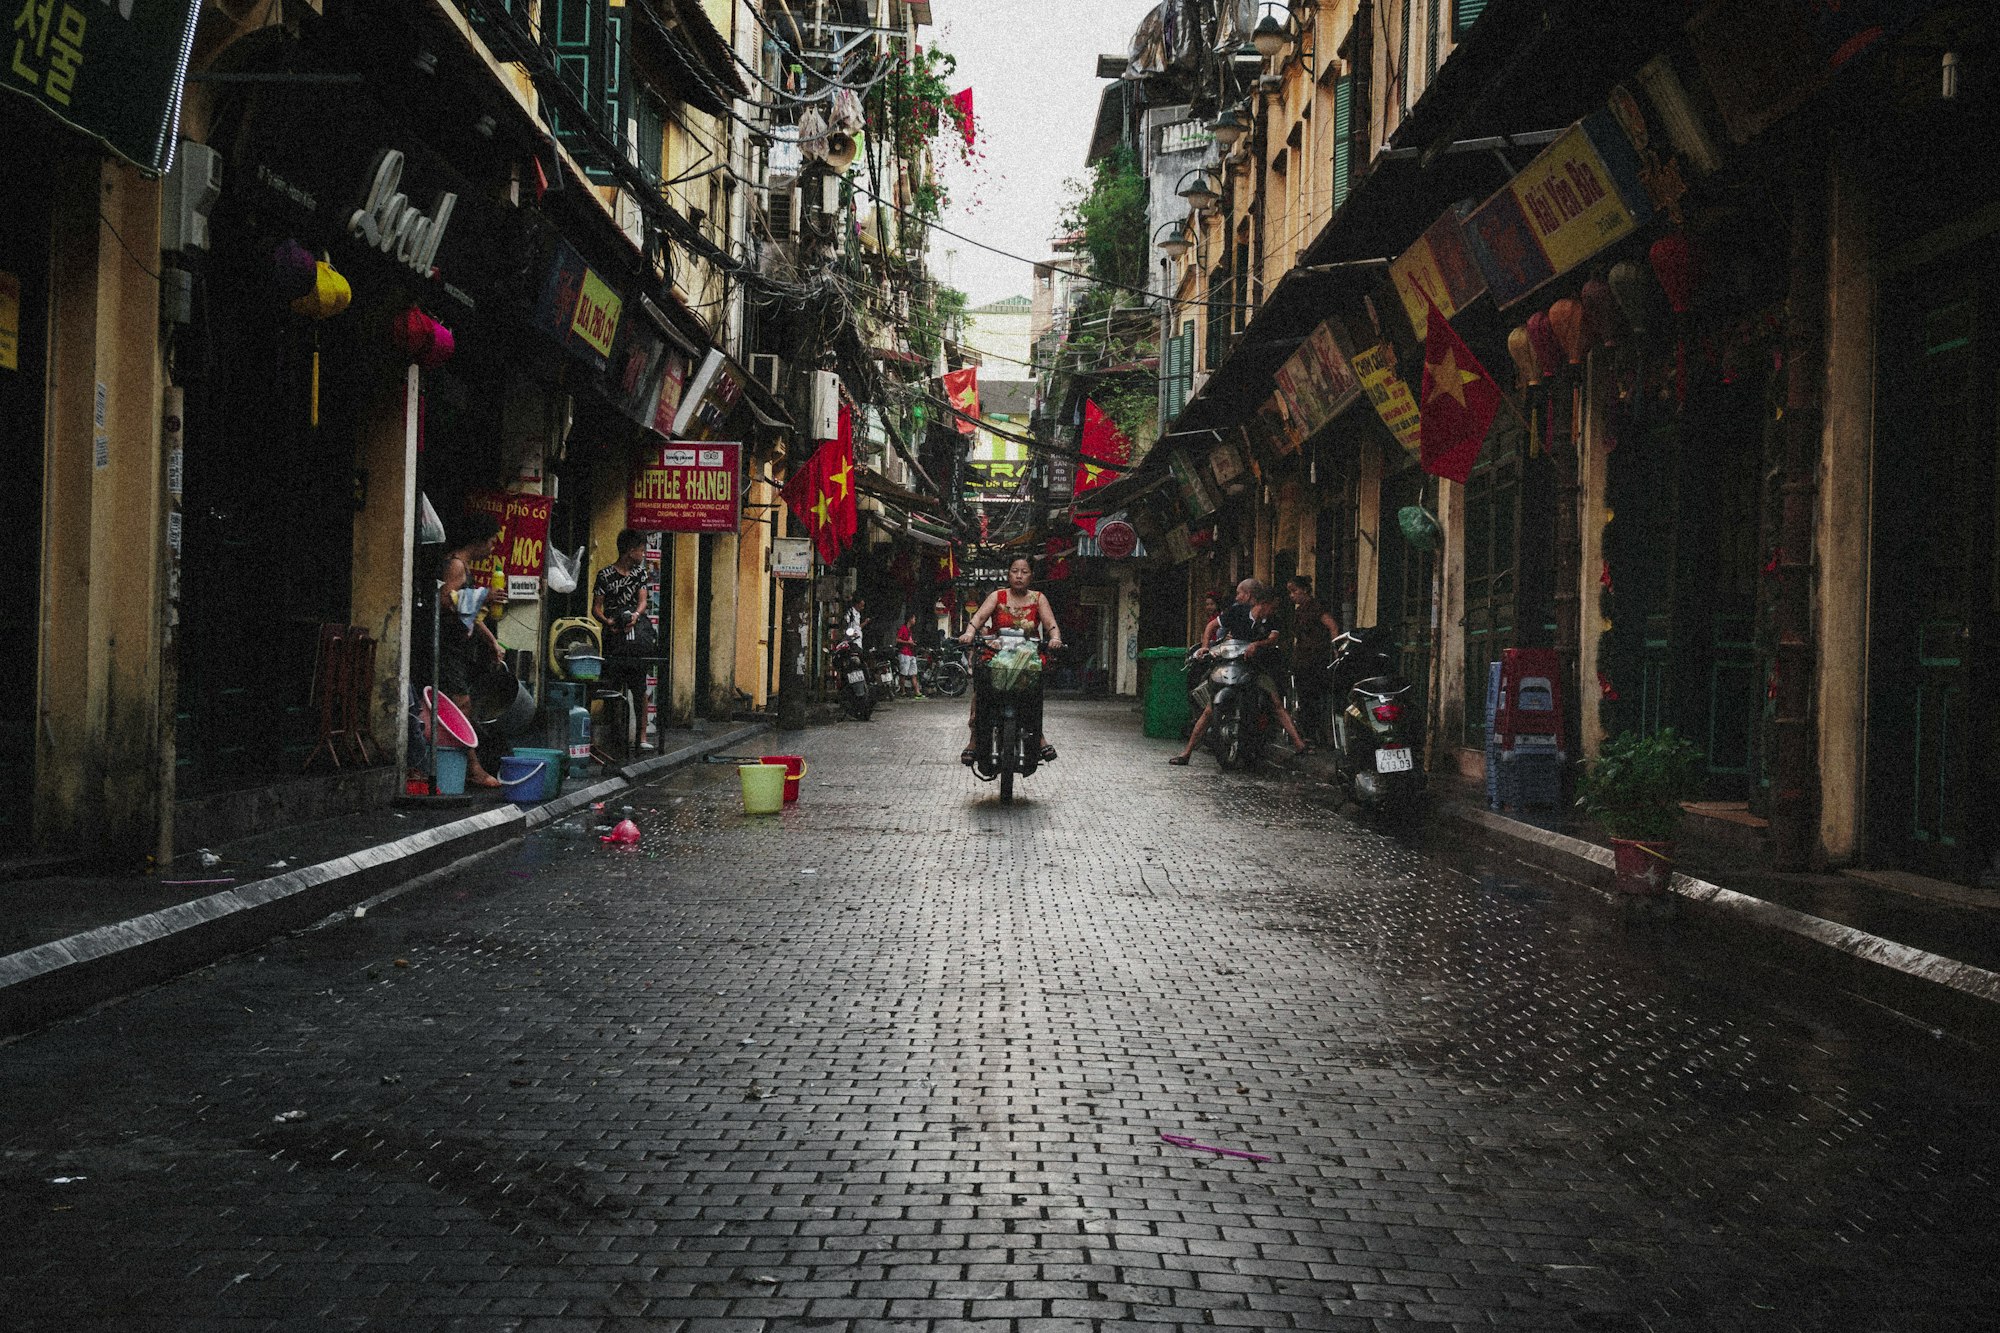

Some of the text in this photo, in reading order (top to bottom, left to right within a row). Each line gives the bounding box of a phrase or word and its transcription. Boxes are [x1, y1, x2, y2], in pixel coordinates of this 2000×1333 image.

[633, 470, 731, 501] LITTLE HANOI
[510, 537, 543, 574] MỌC
